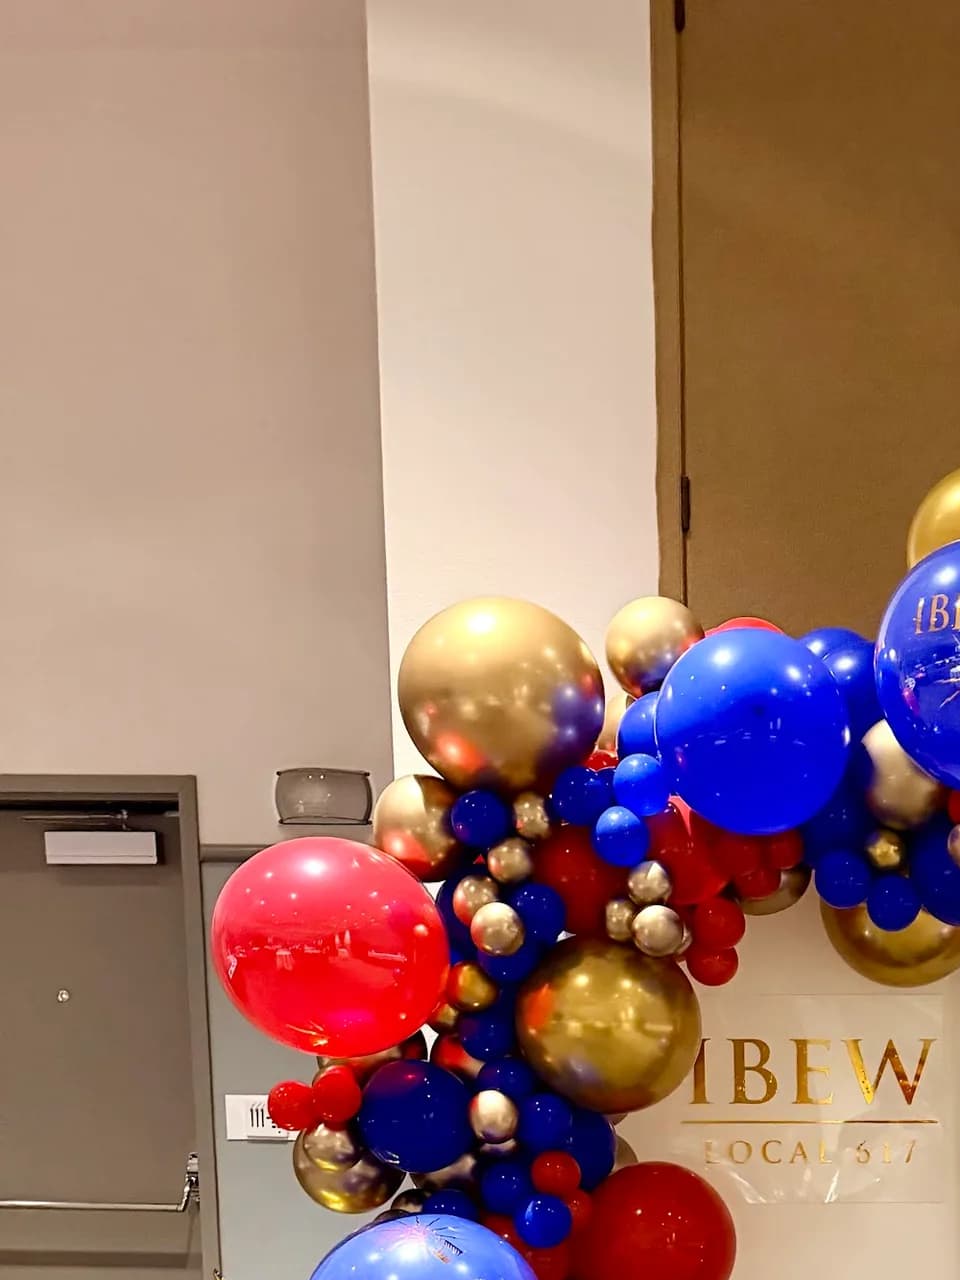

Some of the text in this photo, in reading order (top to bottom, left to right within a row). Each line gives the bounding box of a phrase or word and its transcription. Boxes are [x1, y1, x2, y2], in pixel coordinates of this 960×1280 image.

[689, 1037, 938, 1105] IBEW
[704, 1140, 917, 1164] LOCAL 617
